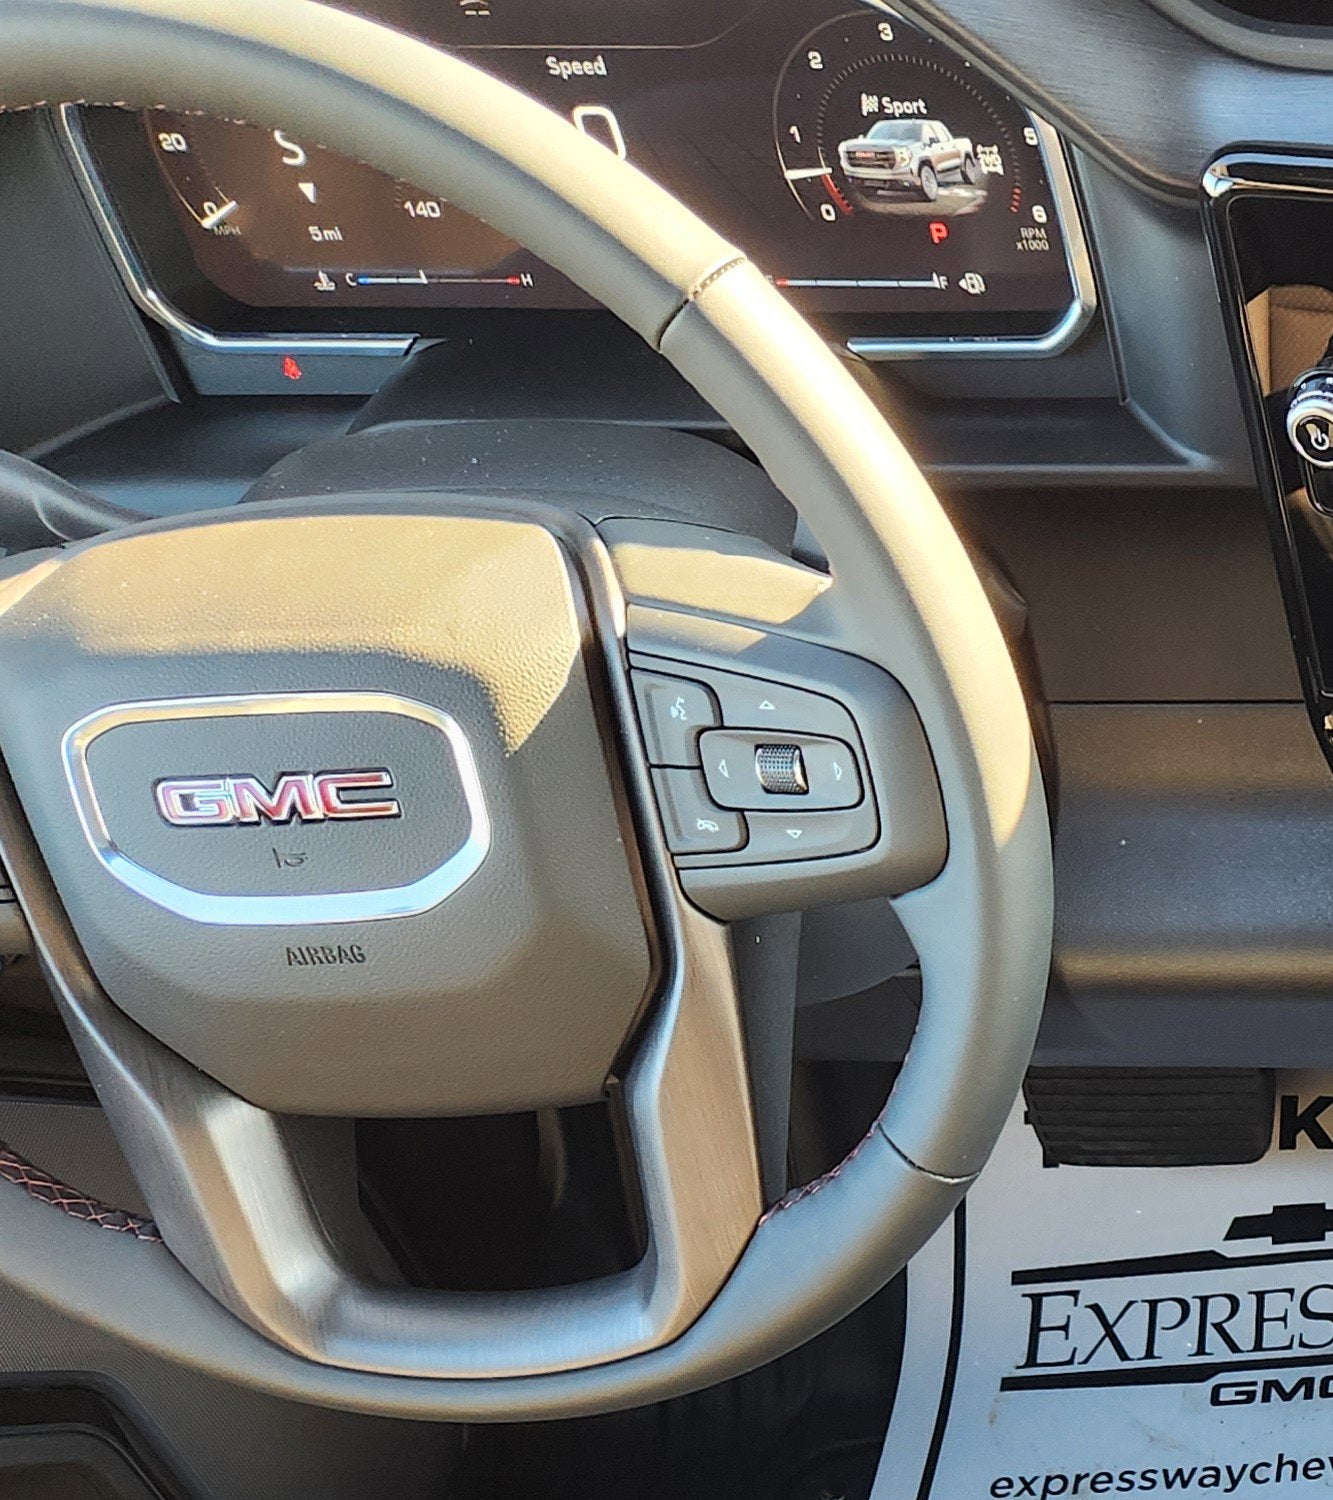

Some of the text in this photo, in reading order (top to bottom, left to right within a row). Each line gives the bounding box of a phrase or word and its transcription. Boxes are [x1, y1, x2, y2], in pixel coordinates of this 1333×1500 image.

[878, 22, 894, 42] 3
[546, 54, 608, 80] Speed
[808, 51, 823, 69] 2
[881, 97, 928, 116] Sport
[158, 132, 188, 153] 20
[789, 125, 801, 143] 1
[403, 201, 441, 218] 140
[820, 203, 836, 223] 0
[929, 221, 949, 244] P
[1020, 227, 1047, 240] RPM
[1016, 238, 1049, 251] x1000
[345, 272, 357, 287] C
[521, 273, 534, 288] H
[154, 767, 403, 827] GMC
[286, 944, 367, 967] AIRBAG
